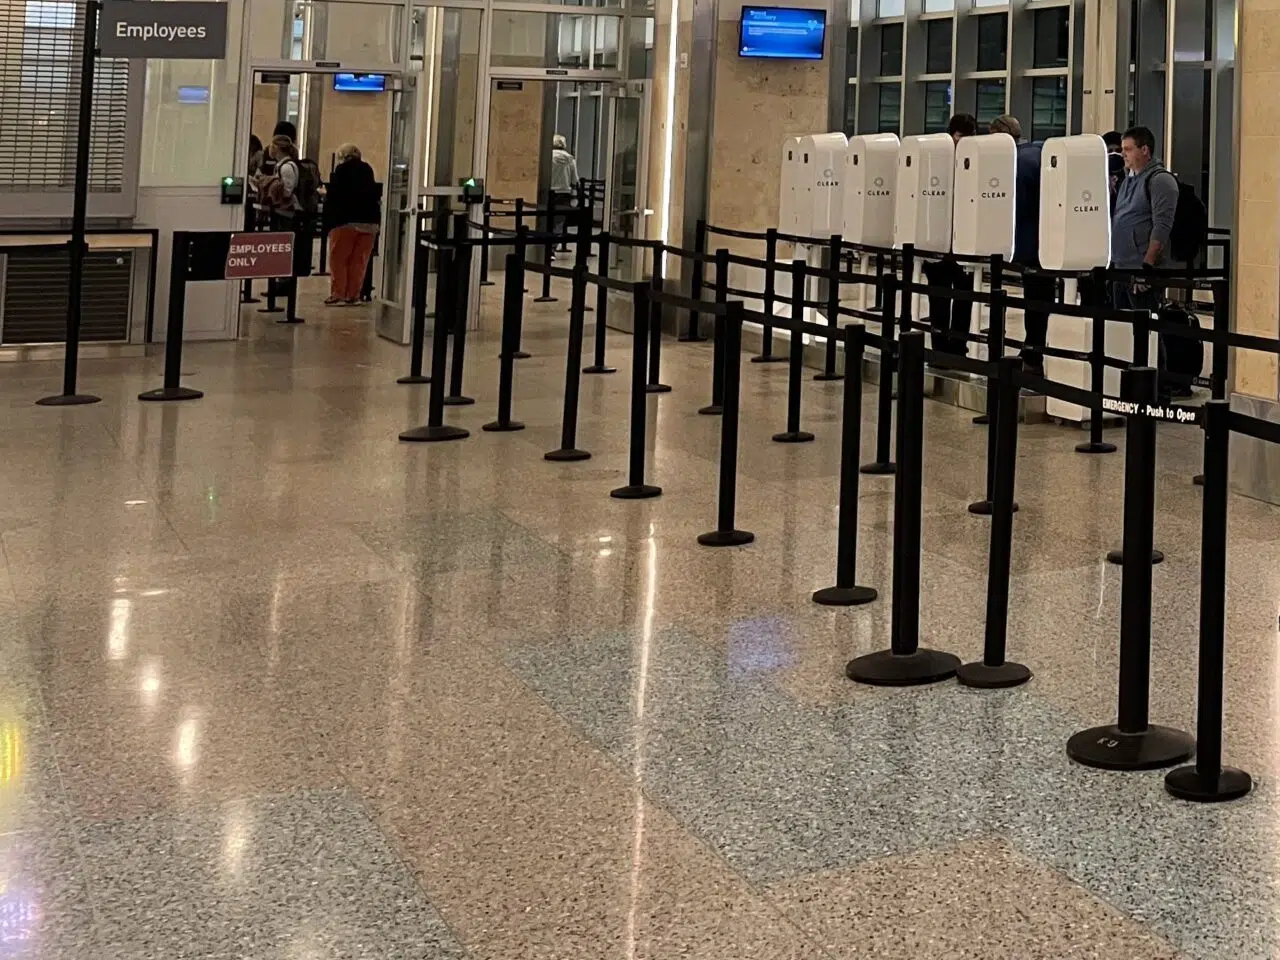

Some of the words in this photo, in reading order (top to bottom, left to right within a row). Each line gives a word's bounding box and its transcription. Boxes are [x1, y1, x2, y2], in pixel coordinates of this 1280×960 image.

[116, 20, 206, 40] Employees
[922, 189, 946, 197] CLEAR
[981, 191, 1007, 199] CLEAR
[1073, 205, 1100, 213] CLEAR
[229, 243, 291, 254] EMPLOYEES
[228, 257, 257, 267] ONLY
[1102, 397, 1139, 415] EMERGENCY
[1146, 404, 1164, 418] Push
[1166, 407, 1174, 419] to
[1176, 408, 1196, 423] Open
